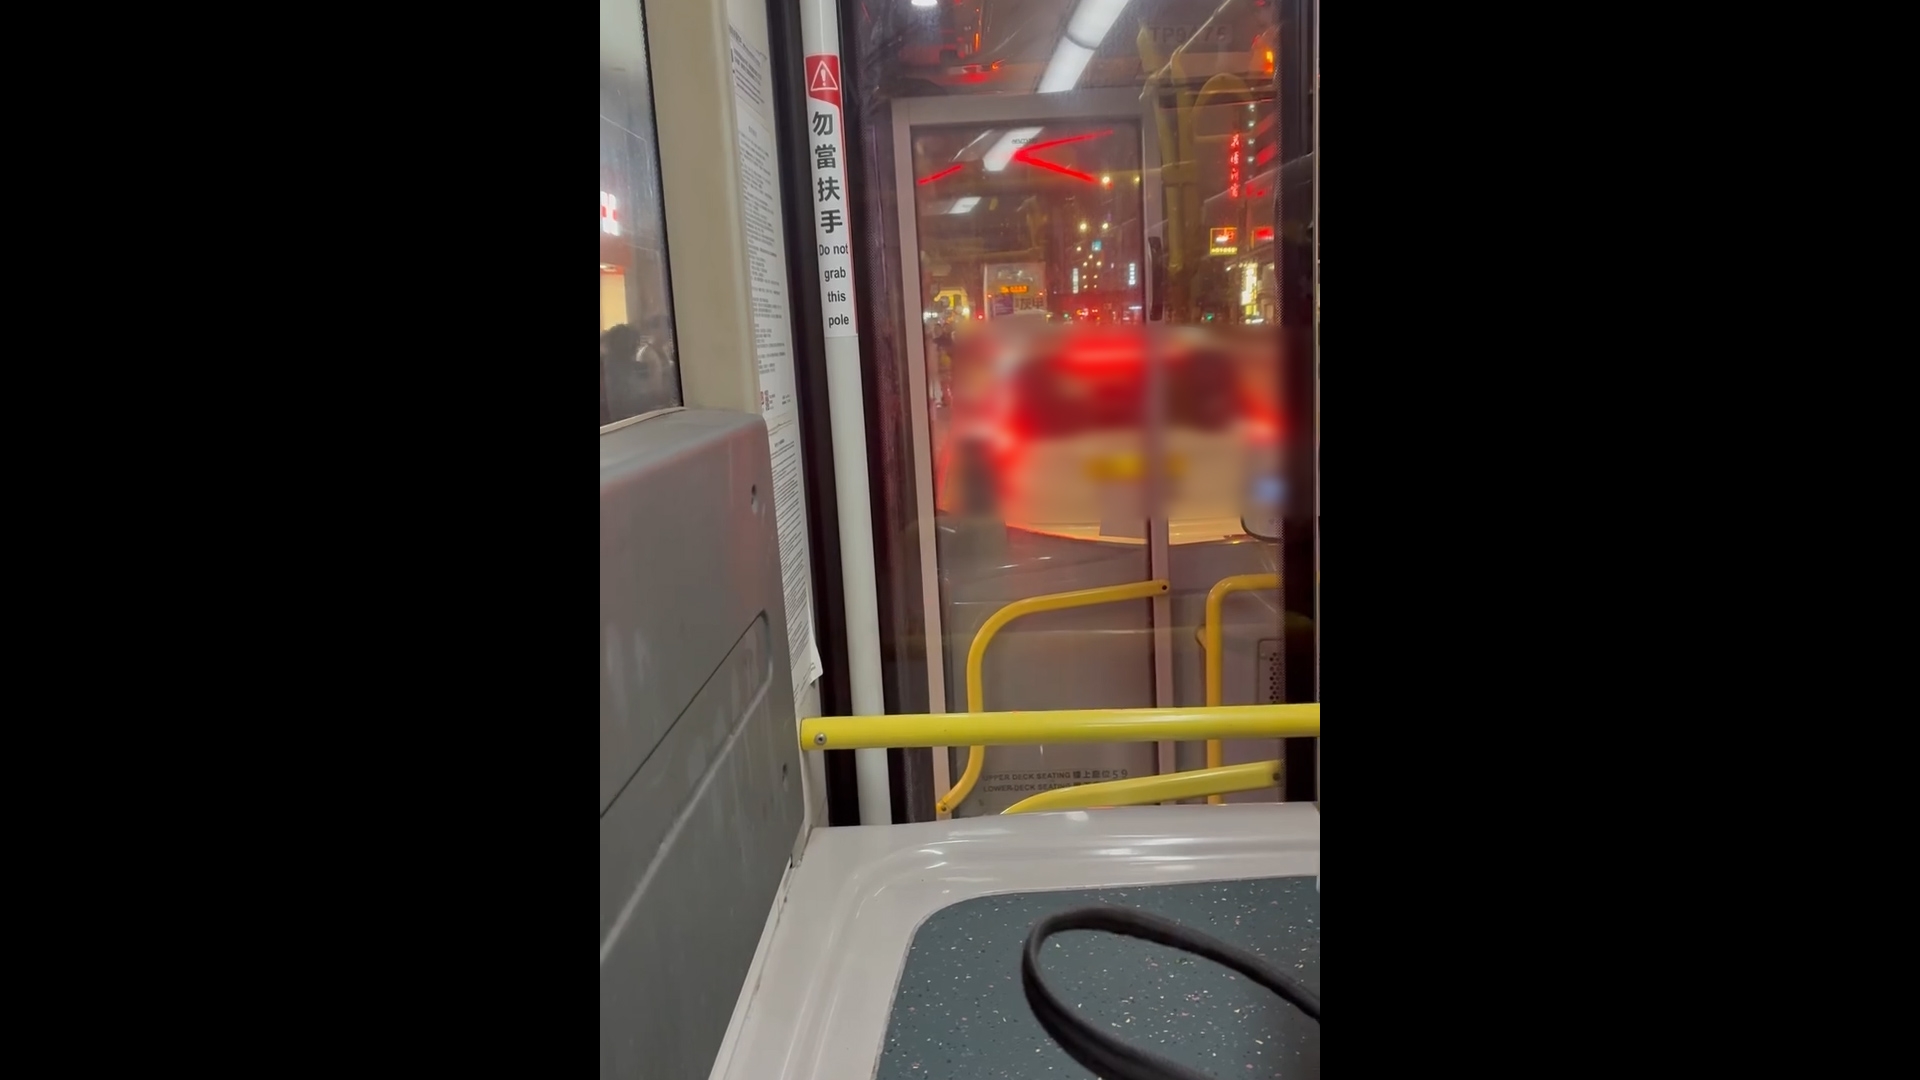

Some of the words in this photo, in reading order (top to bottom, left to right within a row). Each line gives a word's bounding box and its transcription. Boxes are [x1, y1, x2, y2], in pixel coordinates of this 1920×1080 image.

[812, 111, 843, 234] 勿當扶手
[819, 244, 830, 256] Do
[833, 243, 849, 255] not
[824, 266, 846, 282] grab
[827, 290, 846, 303] this
[828, 314, 849, 328] pole
[1036, 771, 1070, 780] SEATING
[983, 785, 1012, 793] LOWER
[1014, 784, 1036, 792] DECK
